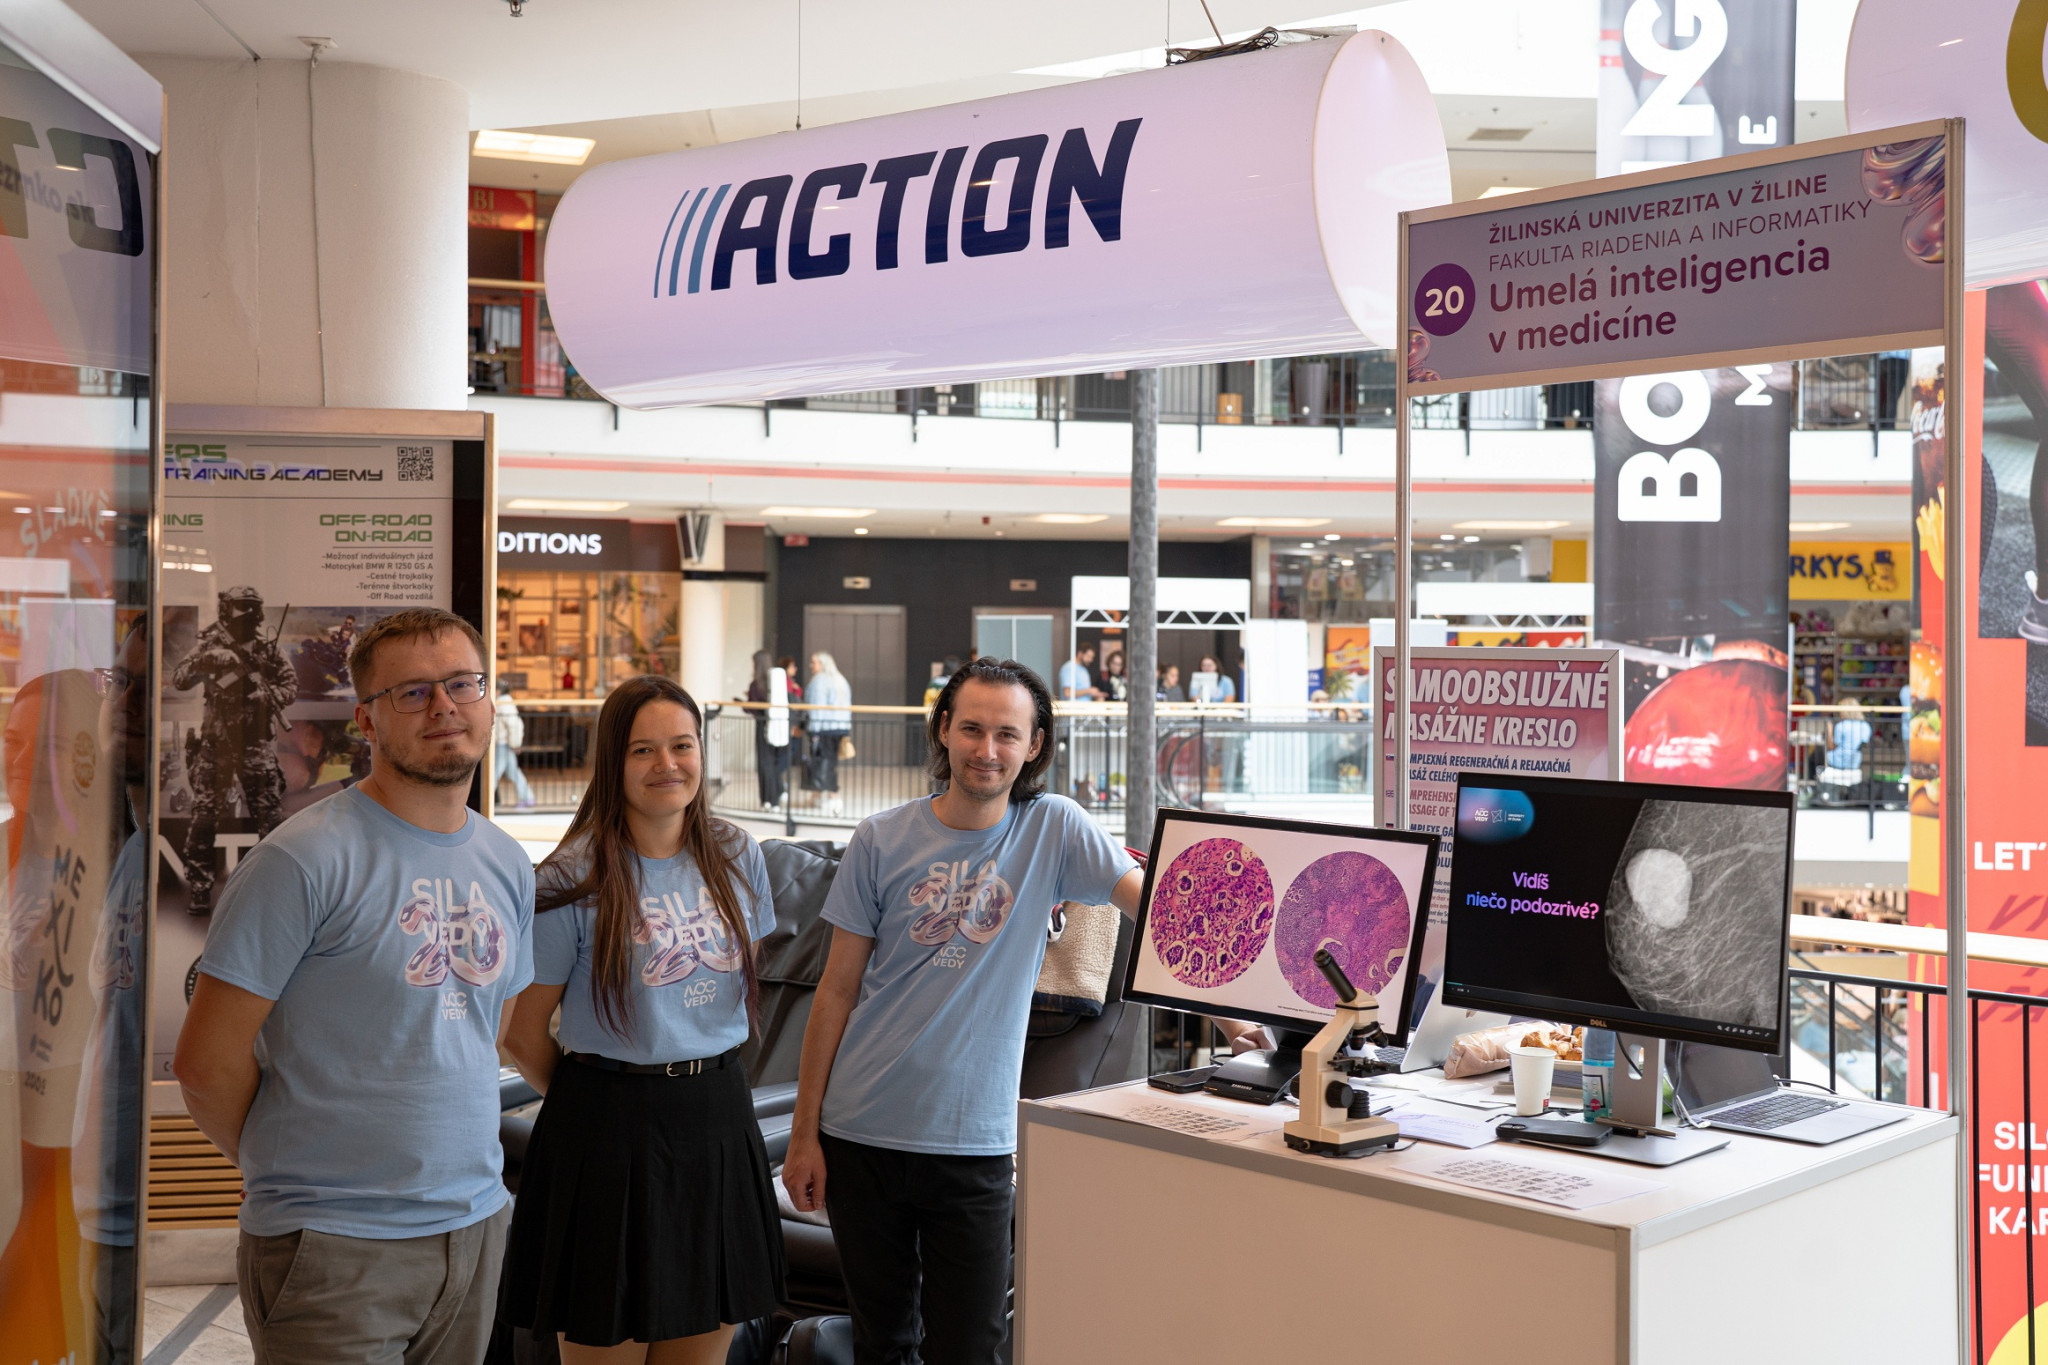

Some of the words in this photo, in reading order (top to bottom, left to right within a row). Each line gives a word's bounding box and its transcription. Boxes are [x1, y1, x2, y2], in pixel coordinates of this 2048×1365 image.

[711, 118, 1143, 291] ACTION
[1489, 213, 1581, 244] ŽILINSKÁ
[1589, 193, 1720, 229] UNIVERZITA
[1727, 187, 1744, 208] V
[1751, 174, 1827, 203] ŽILINE
[1489, 244, 1574, 273] FAKULTA
[1582, 230, 1682, 259] RIADENIA
[1689, 225, 1704, 244] A
[1712, 198, 1873, 240] INFORMATIKY
[1490, 268, 1597, 313] Umelá
[1610, 239, 1830, 295] inteligencia
[1424, 285, 1464, 317] 20
[1489, 330, 1507, 354] v
[1518, 305, 1677, 353] medicíne
[164, 467, 266, 481] TRAINING
[270, 468, 384, 482] ACADEMY
[320, 514, 433, 527] OFF-ROAD
[335, 530, 433, 542] ON-ROAD
[360, 552, 415, 562] individuálnych
[416, 552, 434, 562] jázd
[365, 562, 386, 570] BMW
[387, 562, 394, 570] R
[395, 562, 413, 570] 1250
[414, 562, 426, 570] GS
[427, 562, 434, 570] A
[398, 572, 434, 582] trojkolky
[392, 582, 434, 591] štvorkolky
[383, 592, 404, 600] Road
[1492, 716, 1577, 748] KRESLO
[1450, 755, 1509, 771] REGENERAČNÁ
[1511, 760, 1518, 770] A
[1519, 758, 1571, 774] RELAXAČNÁ
[1428, 768, 1458, 783] CELÉHO
[1438, 805, 1450, 817] OF
[928, 860, 998, 889] SILA
[1512, 871, 1549, 890] Vidíš
[412, 878, 487, 917] SILA
[640, 886, 719, 924] SILA
[1466, 891, 1507, 910] niečo
[1510, 898, 1599, 920] podozrivé?
[933, 957, 965, 969] VEDY
[683, 993, 717, 1009] VEDY
[441, 1008, 467, 1021] VEDY
[1590, 1019, 1607, 1028] DELL
[1994, 1121, 2048, 1150] SIL
